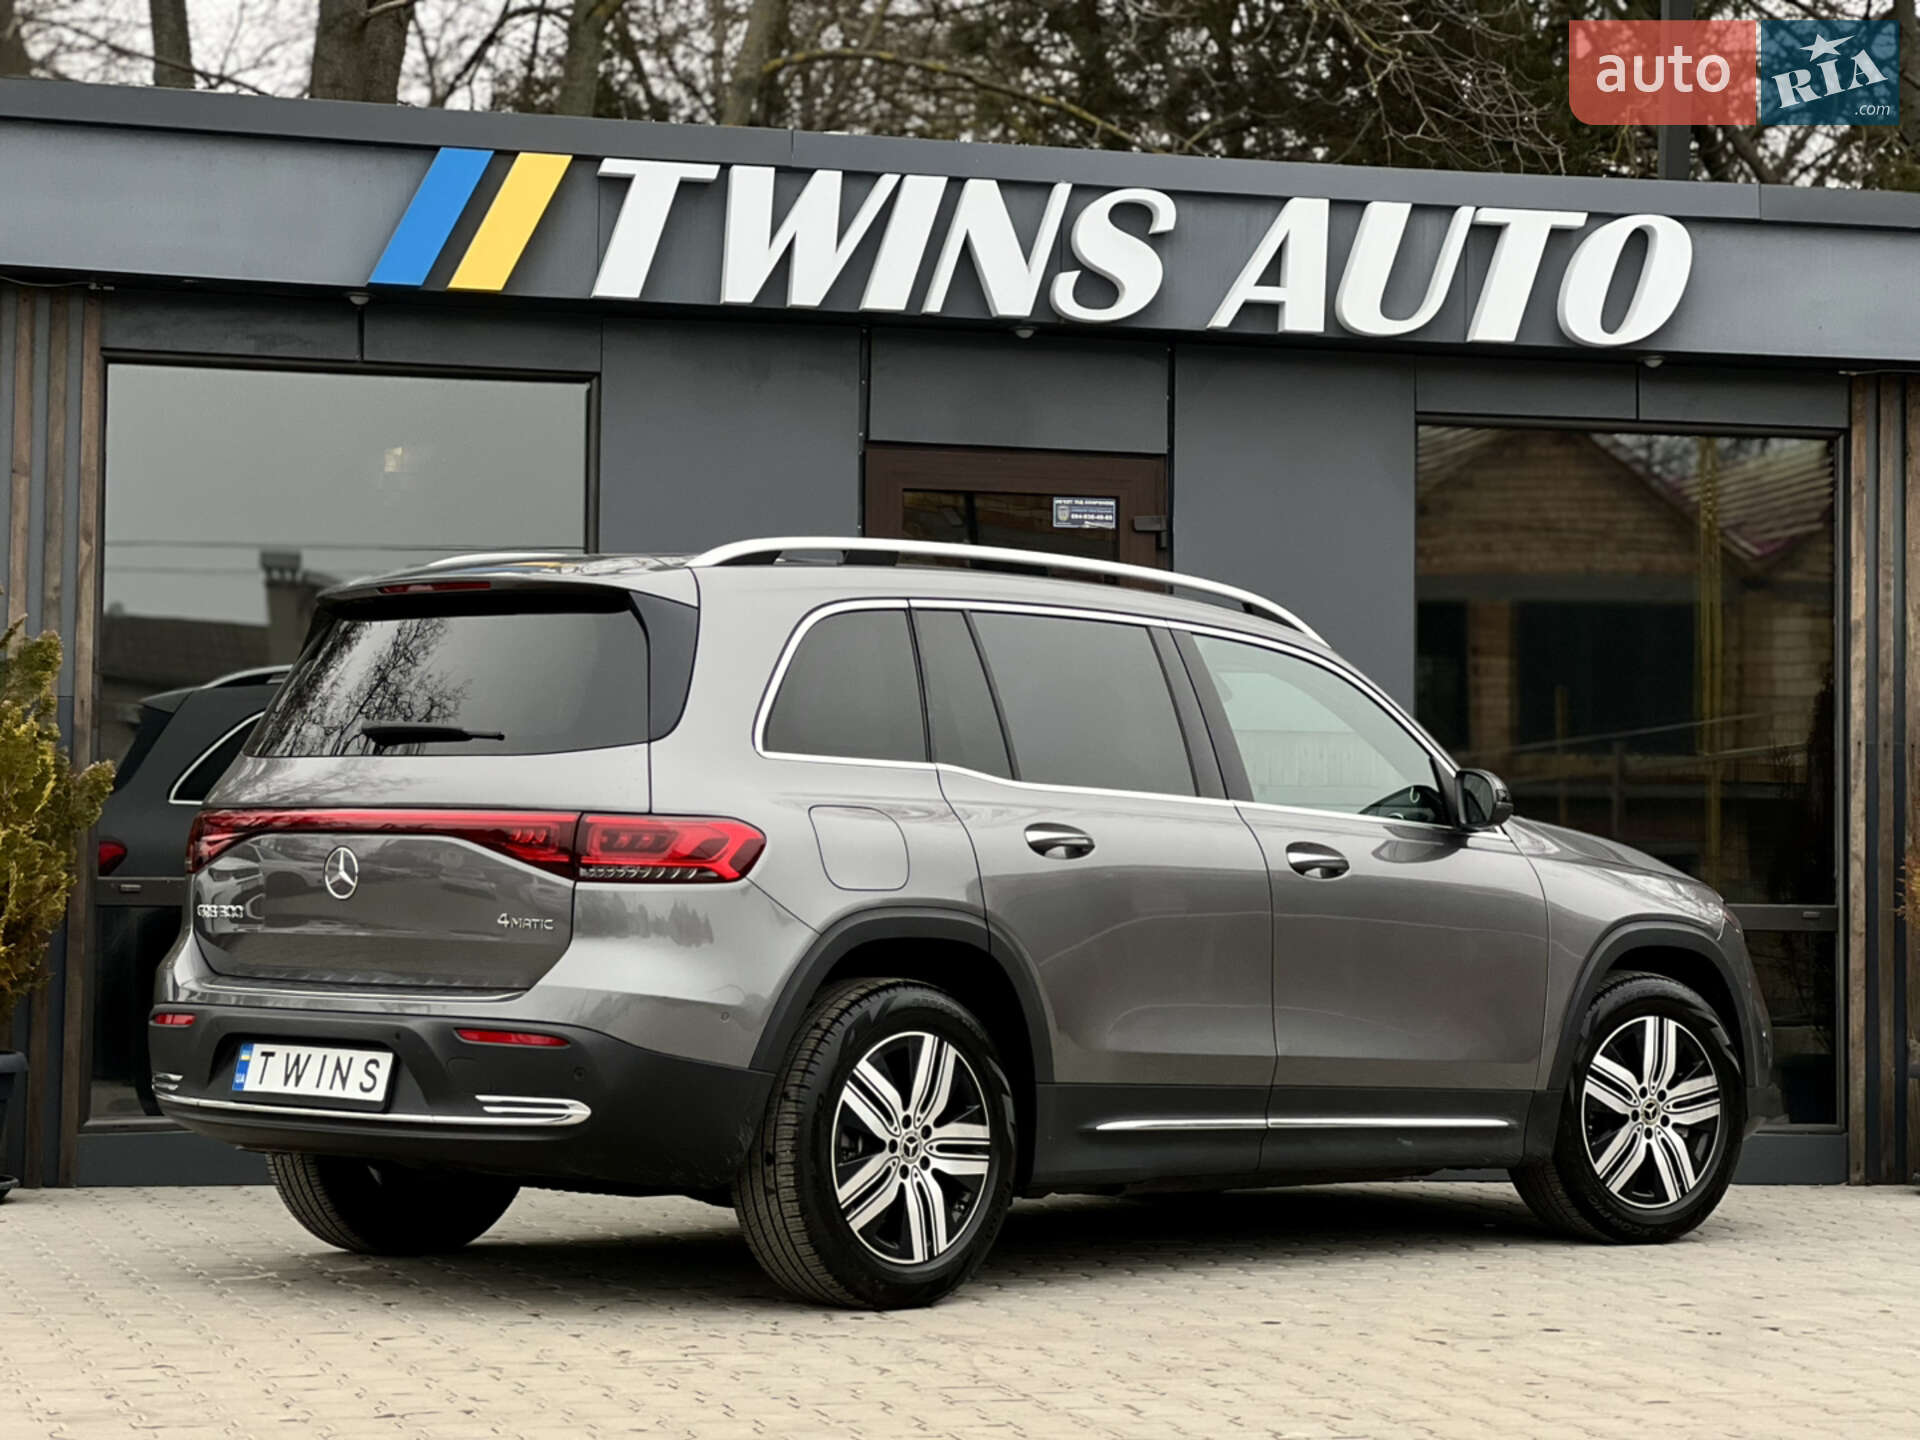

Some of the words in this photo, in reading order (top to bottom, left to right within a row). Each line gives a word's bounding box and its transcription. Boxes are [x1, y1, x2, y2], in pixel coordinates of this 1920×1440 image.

[591, 157, 1177, 323] TWINS
[1205, 196, 1693, 348] AUTO
[258, 1051, 380, 1093] TWINS
